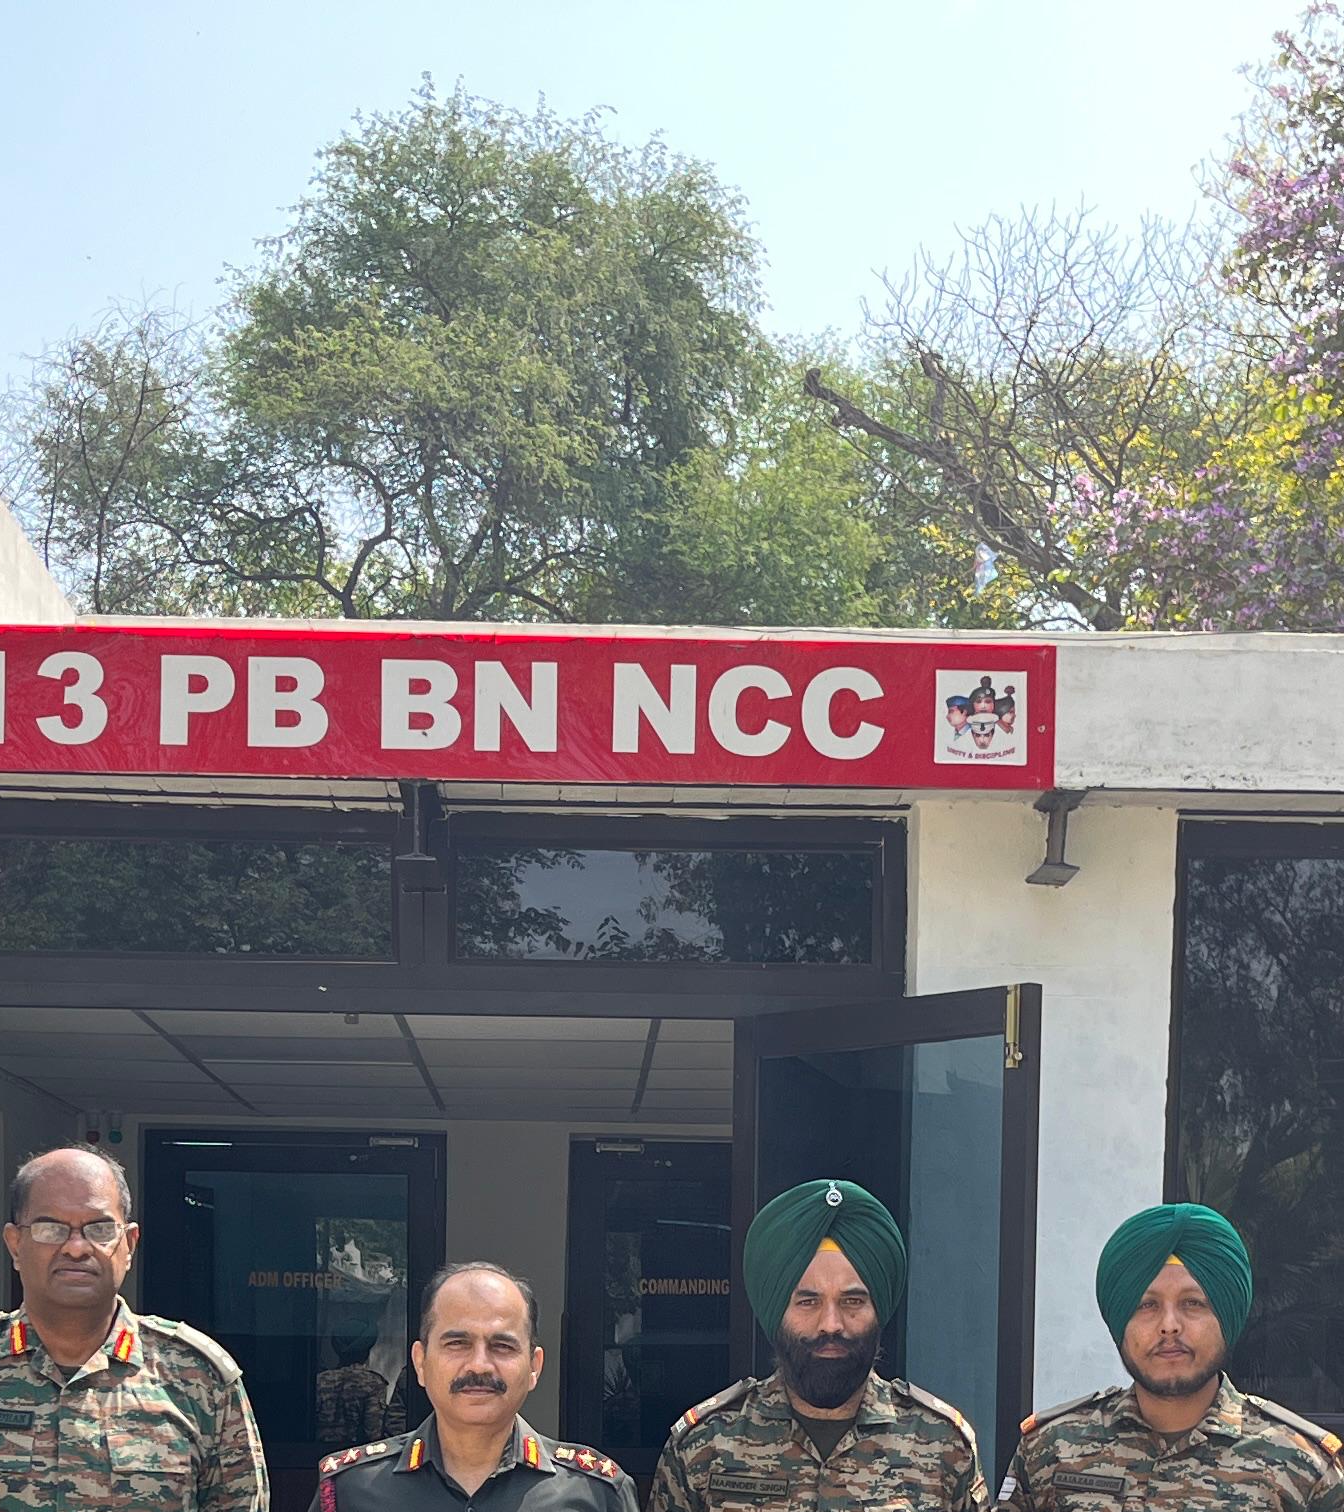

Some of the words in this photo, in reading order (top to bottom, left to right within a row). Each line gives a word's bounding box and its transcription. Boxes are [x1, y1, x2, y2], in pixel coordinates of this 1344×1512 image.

[160, 655, 328, 748] PB
[381, 659, 557, 753] BN
[613, 663, 885, 760] NCC
[946, 746, 966, 758] UNITY
[247, 1271, 278, 1287] ADM
[282, 1271, 342, 1289] OFFICER
[640, 1279, 730, 1295] COMMANDING
[711, 1478, 756, 1490] NARINDER
[760, 1483, 786, 1492] SINGH
